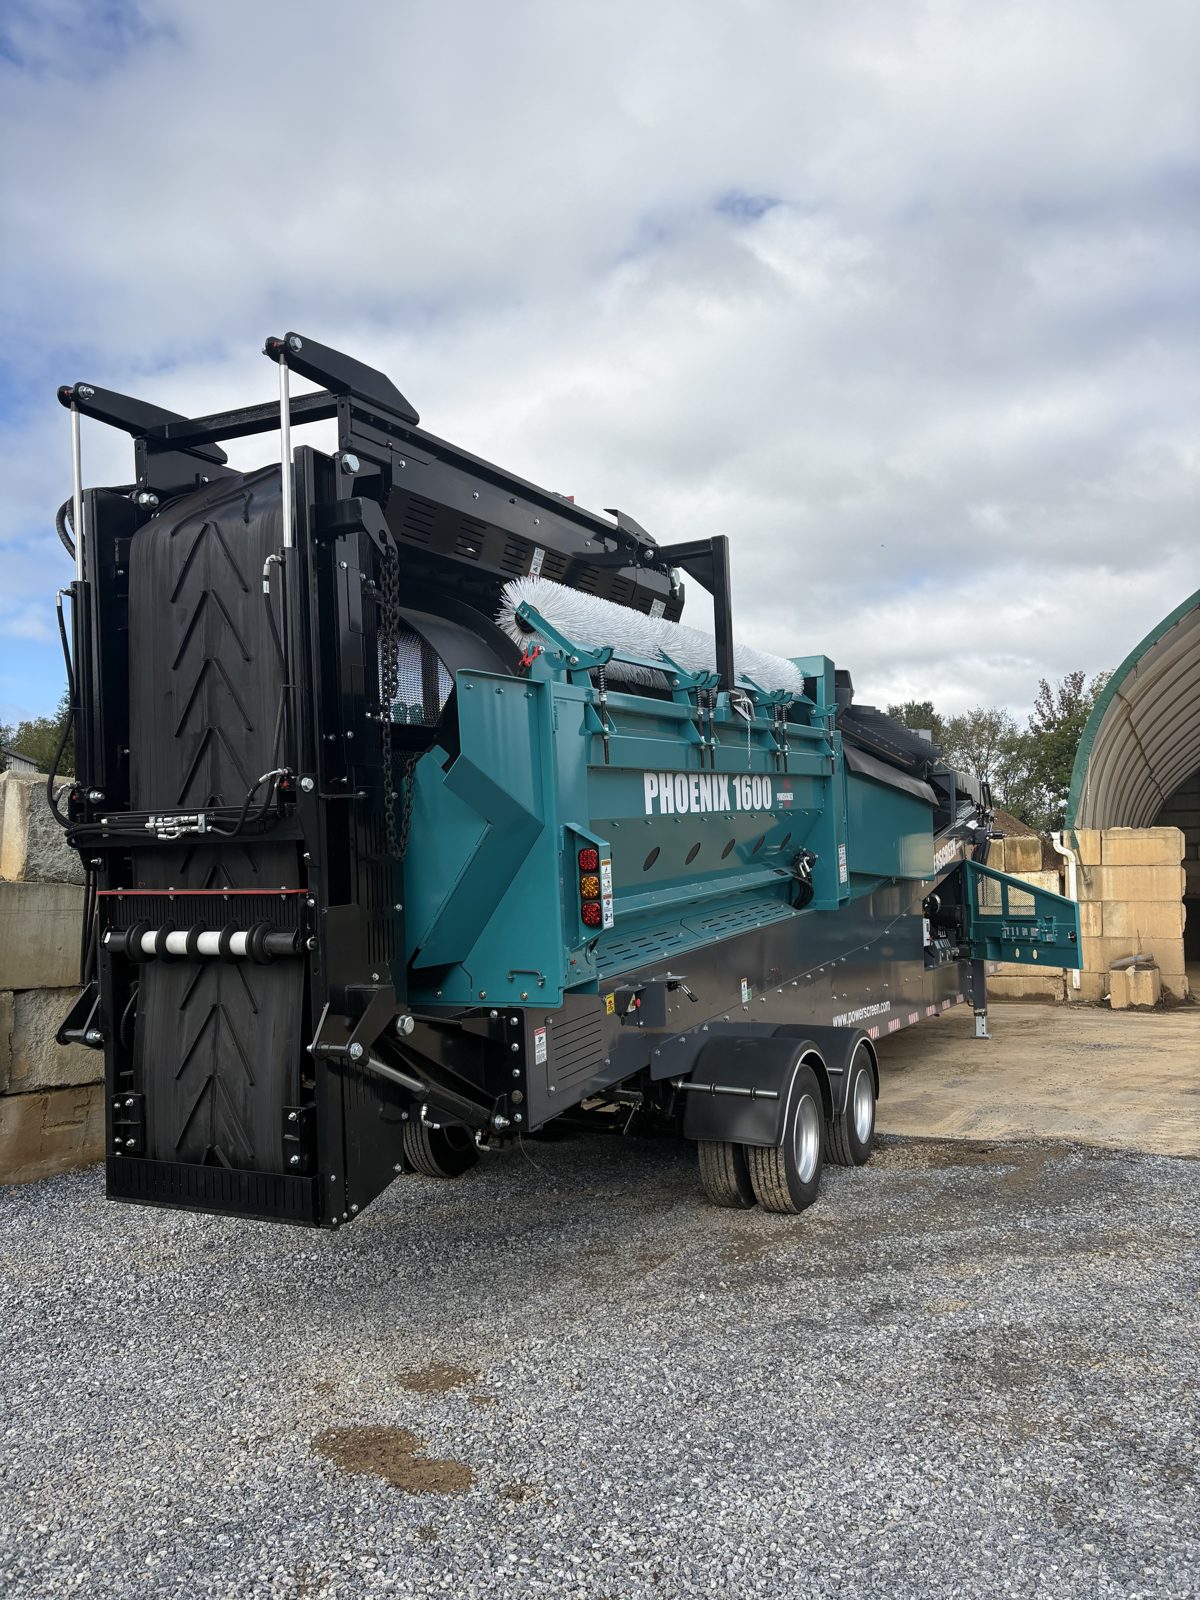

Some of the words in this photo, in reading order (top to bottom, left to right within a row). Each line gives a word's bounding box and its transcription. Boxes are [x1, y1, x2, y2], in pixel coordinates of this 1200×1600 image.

[643, 772, 731, 815] PHOENIX
[732, 774, 773, 811] 1600
[832, 1000, 891, 1028] www.powerscreen.com
